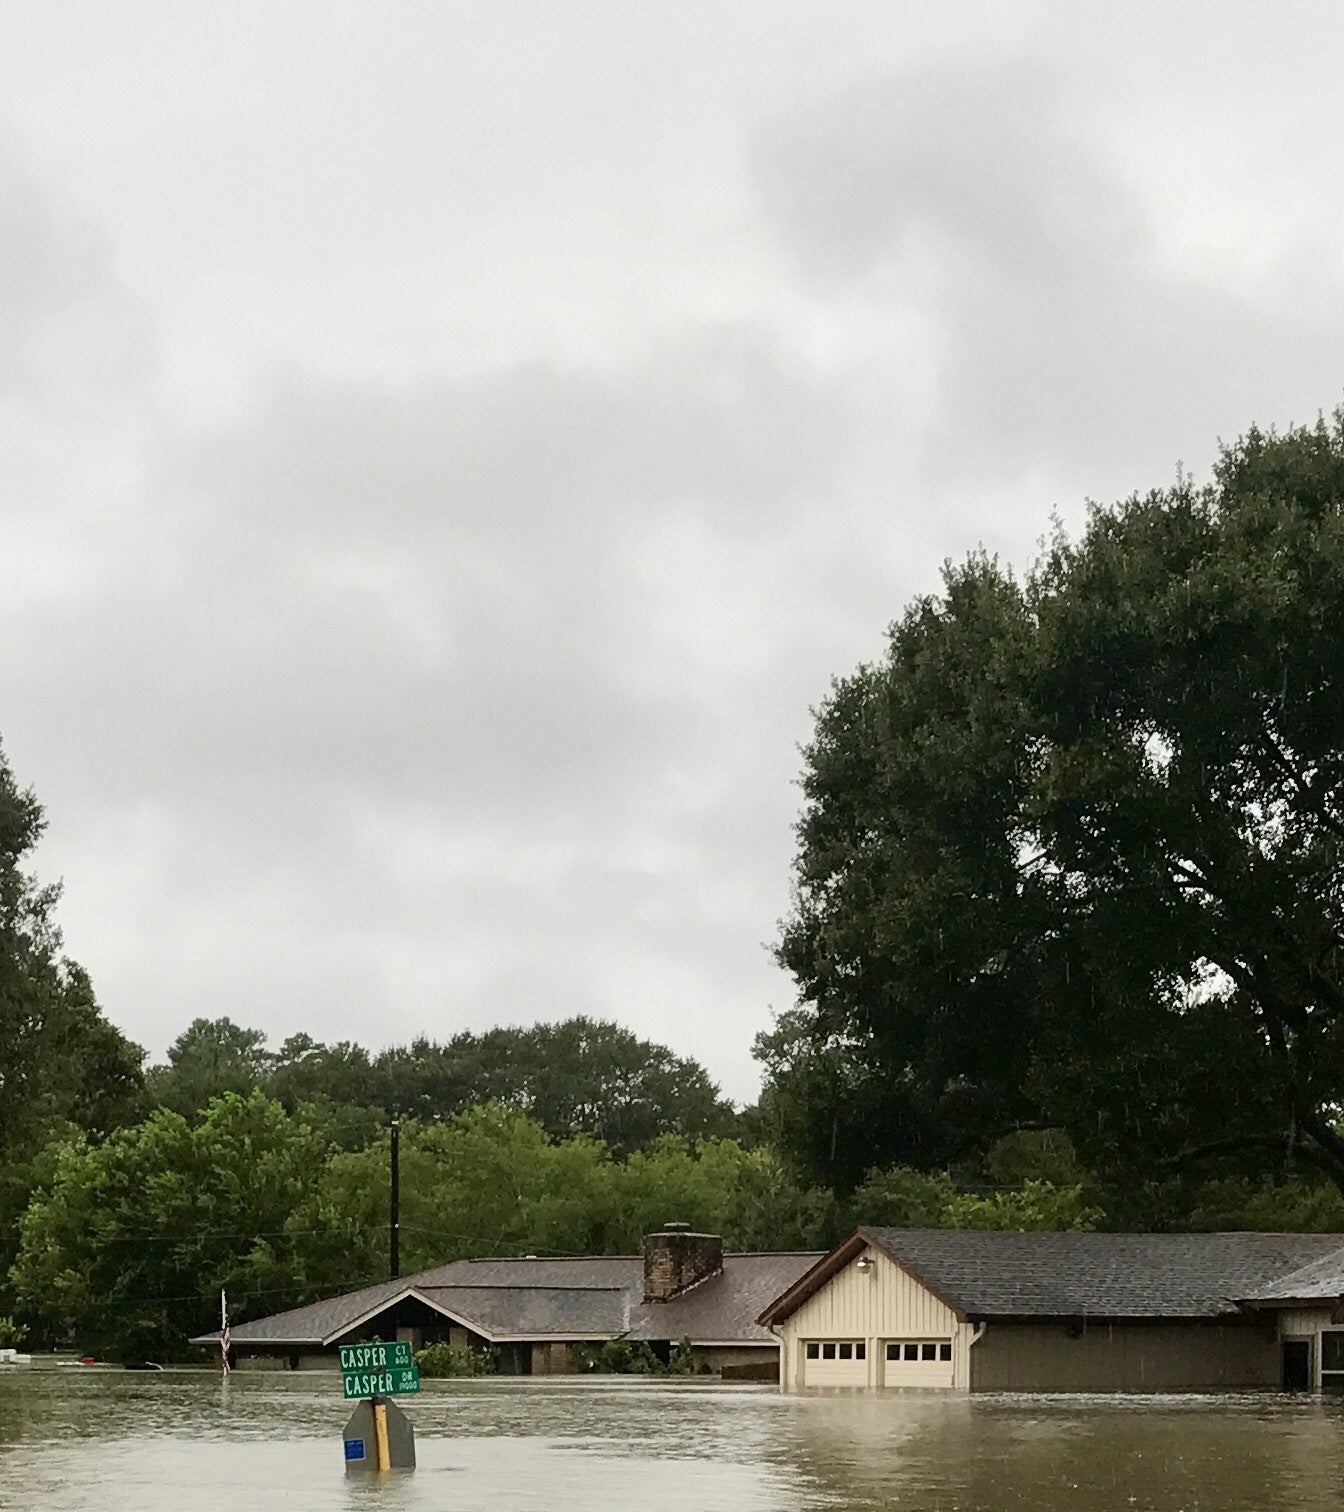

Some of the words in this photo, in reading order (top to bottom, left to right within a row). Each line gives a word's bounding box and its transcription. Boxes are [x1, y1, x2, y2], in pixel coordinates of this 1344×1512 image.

[341, 1347, 387, 1368] CASPER
[396, 1345, 406, 1356] CT
[345, 1373, 393, 1396] CASPER
[402, 1371, 413, 1381] DR
